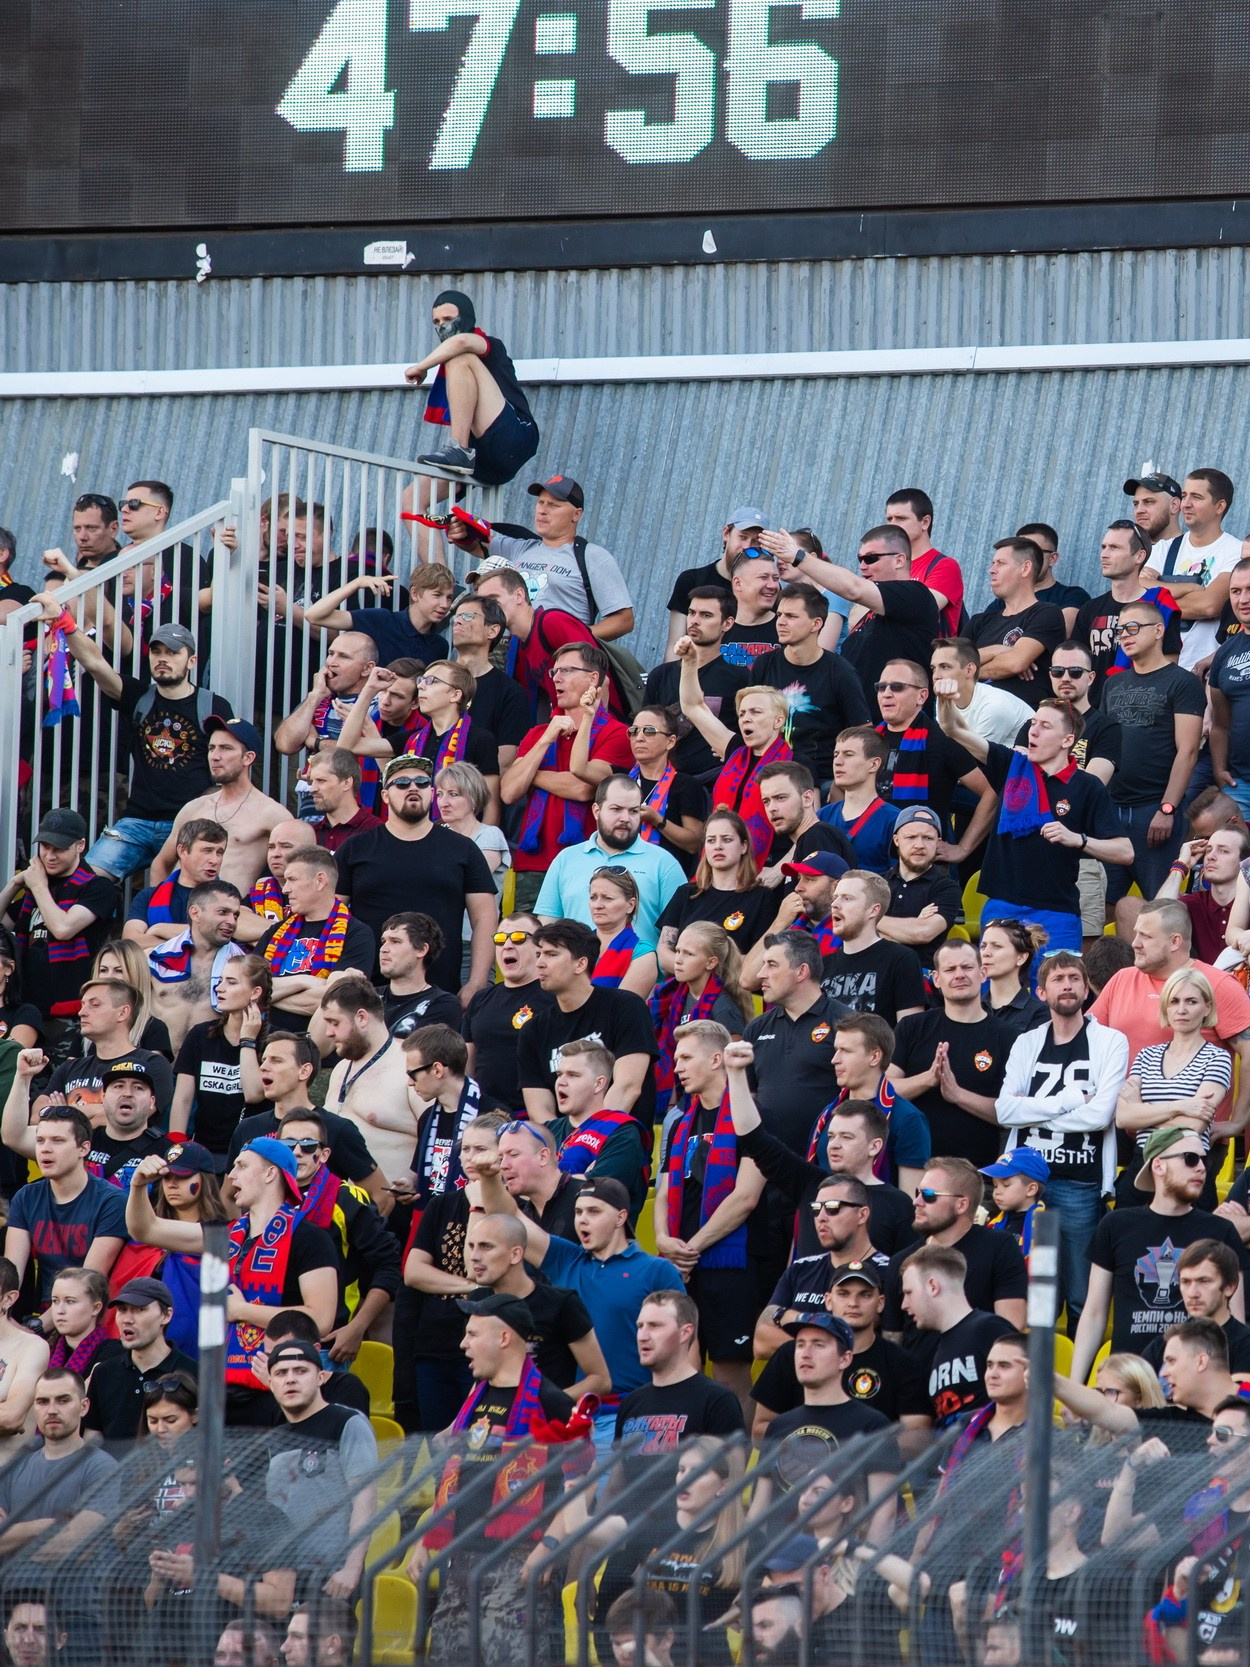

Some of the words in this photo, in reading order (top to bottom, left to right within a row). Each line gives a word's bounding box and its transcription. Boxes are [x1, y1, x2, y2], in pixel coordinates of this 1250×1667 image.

[275, 0, 841, 173] 47:56
[213, 1065, 227, 1075] WE
[227, 1068, 240, 1077] ARE
[203, 1080, 225, 1091] CSKA
[225, 1082, 243, 1092] GIRL
[794, 1292, 809, 1303] WE
[1129, 1323, 1158, 1335] РОССИИ
